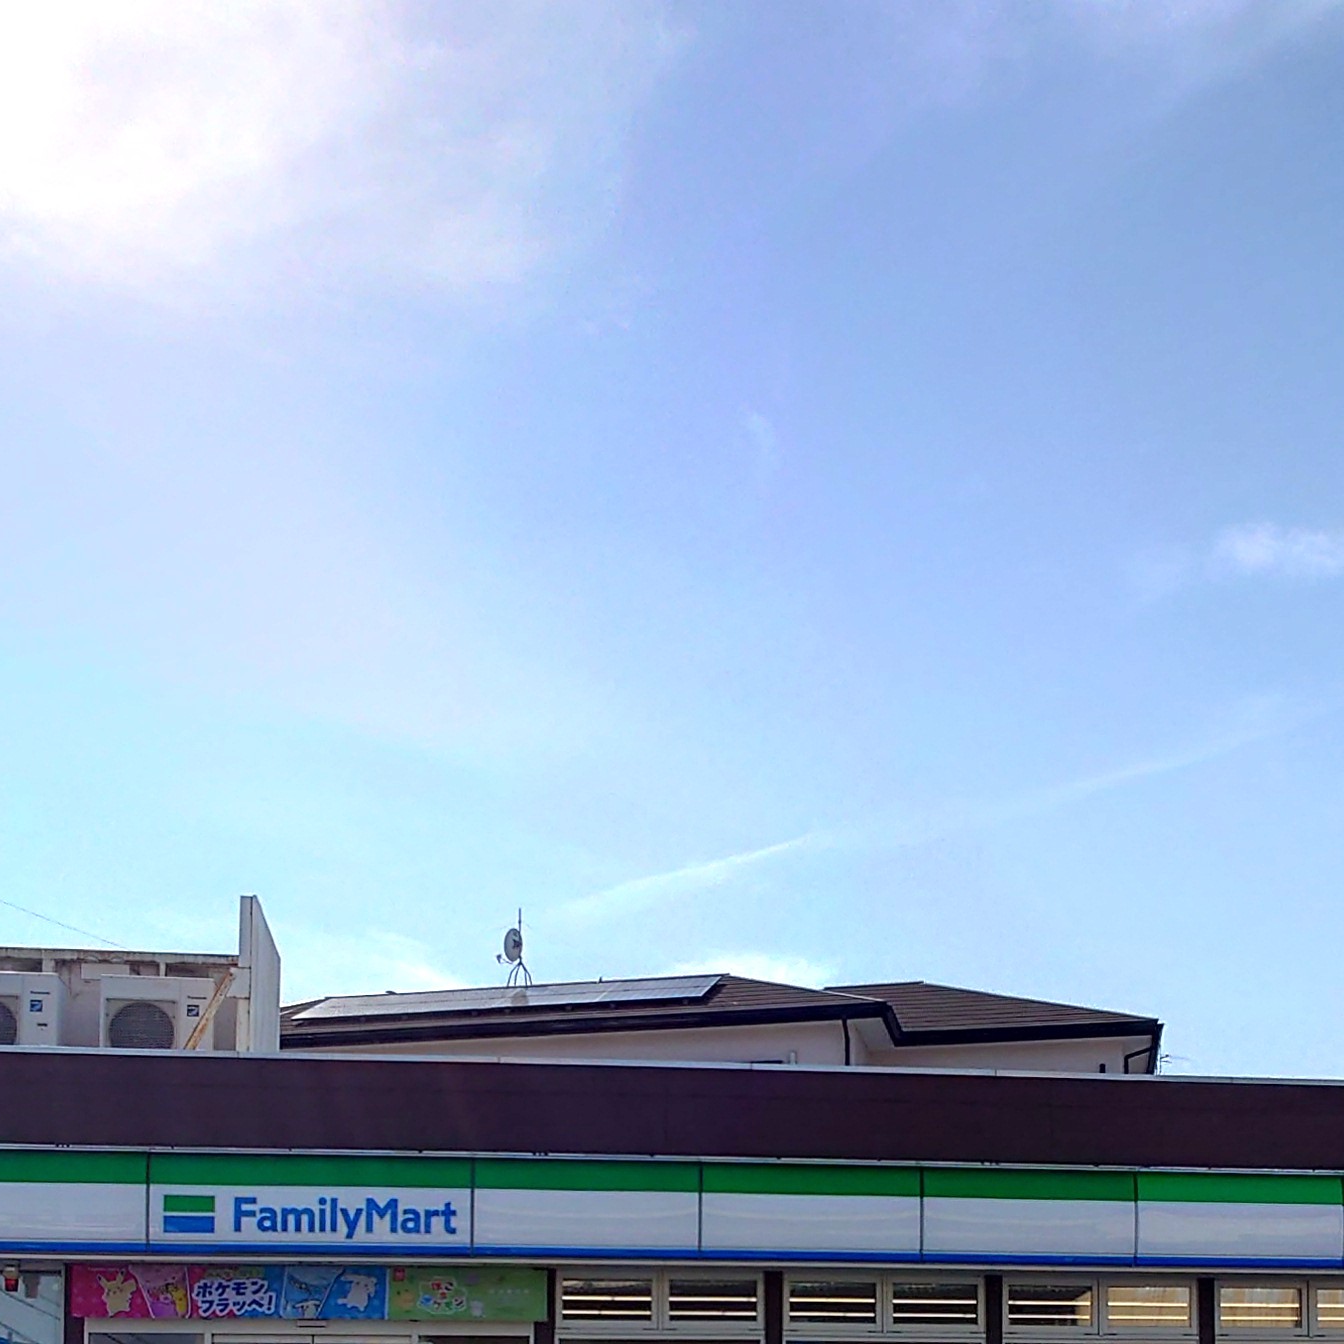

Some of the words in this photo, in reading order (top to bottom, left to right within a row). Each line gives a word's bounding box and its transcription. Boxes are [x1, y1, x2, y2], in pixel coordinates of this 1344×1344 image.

[233, 1197, 456, 1239] FamilyMart
[195, 1280, 267, 1298] ポケモン
[200, 1294, 273, 1313] フラッペ!
